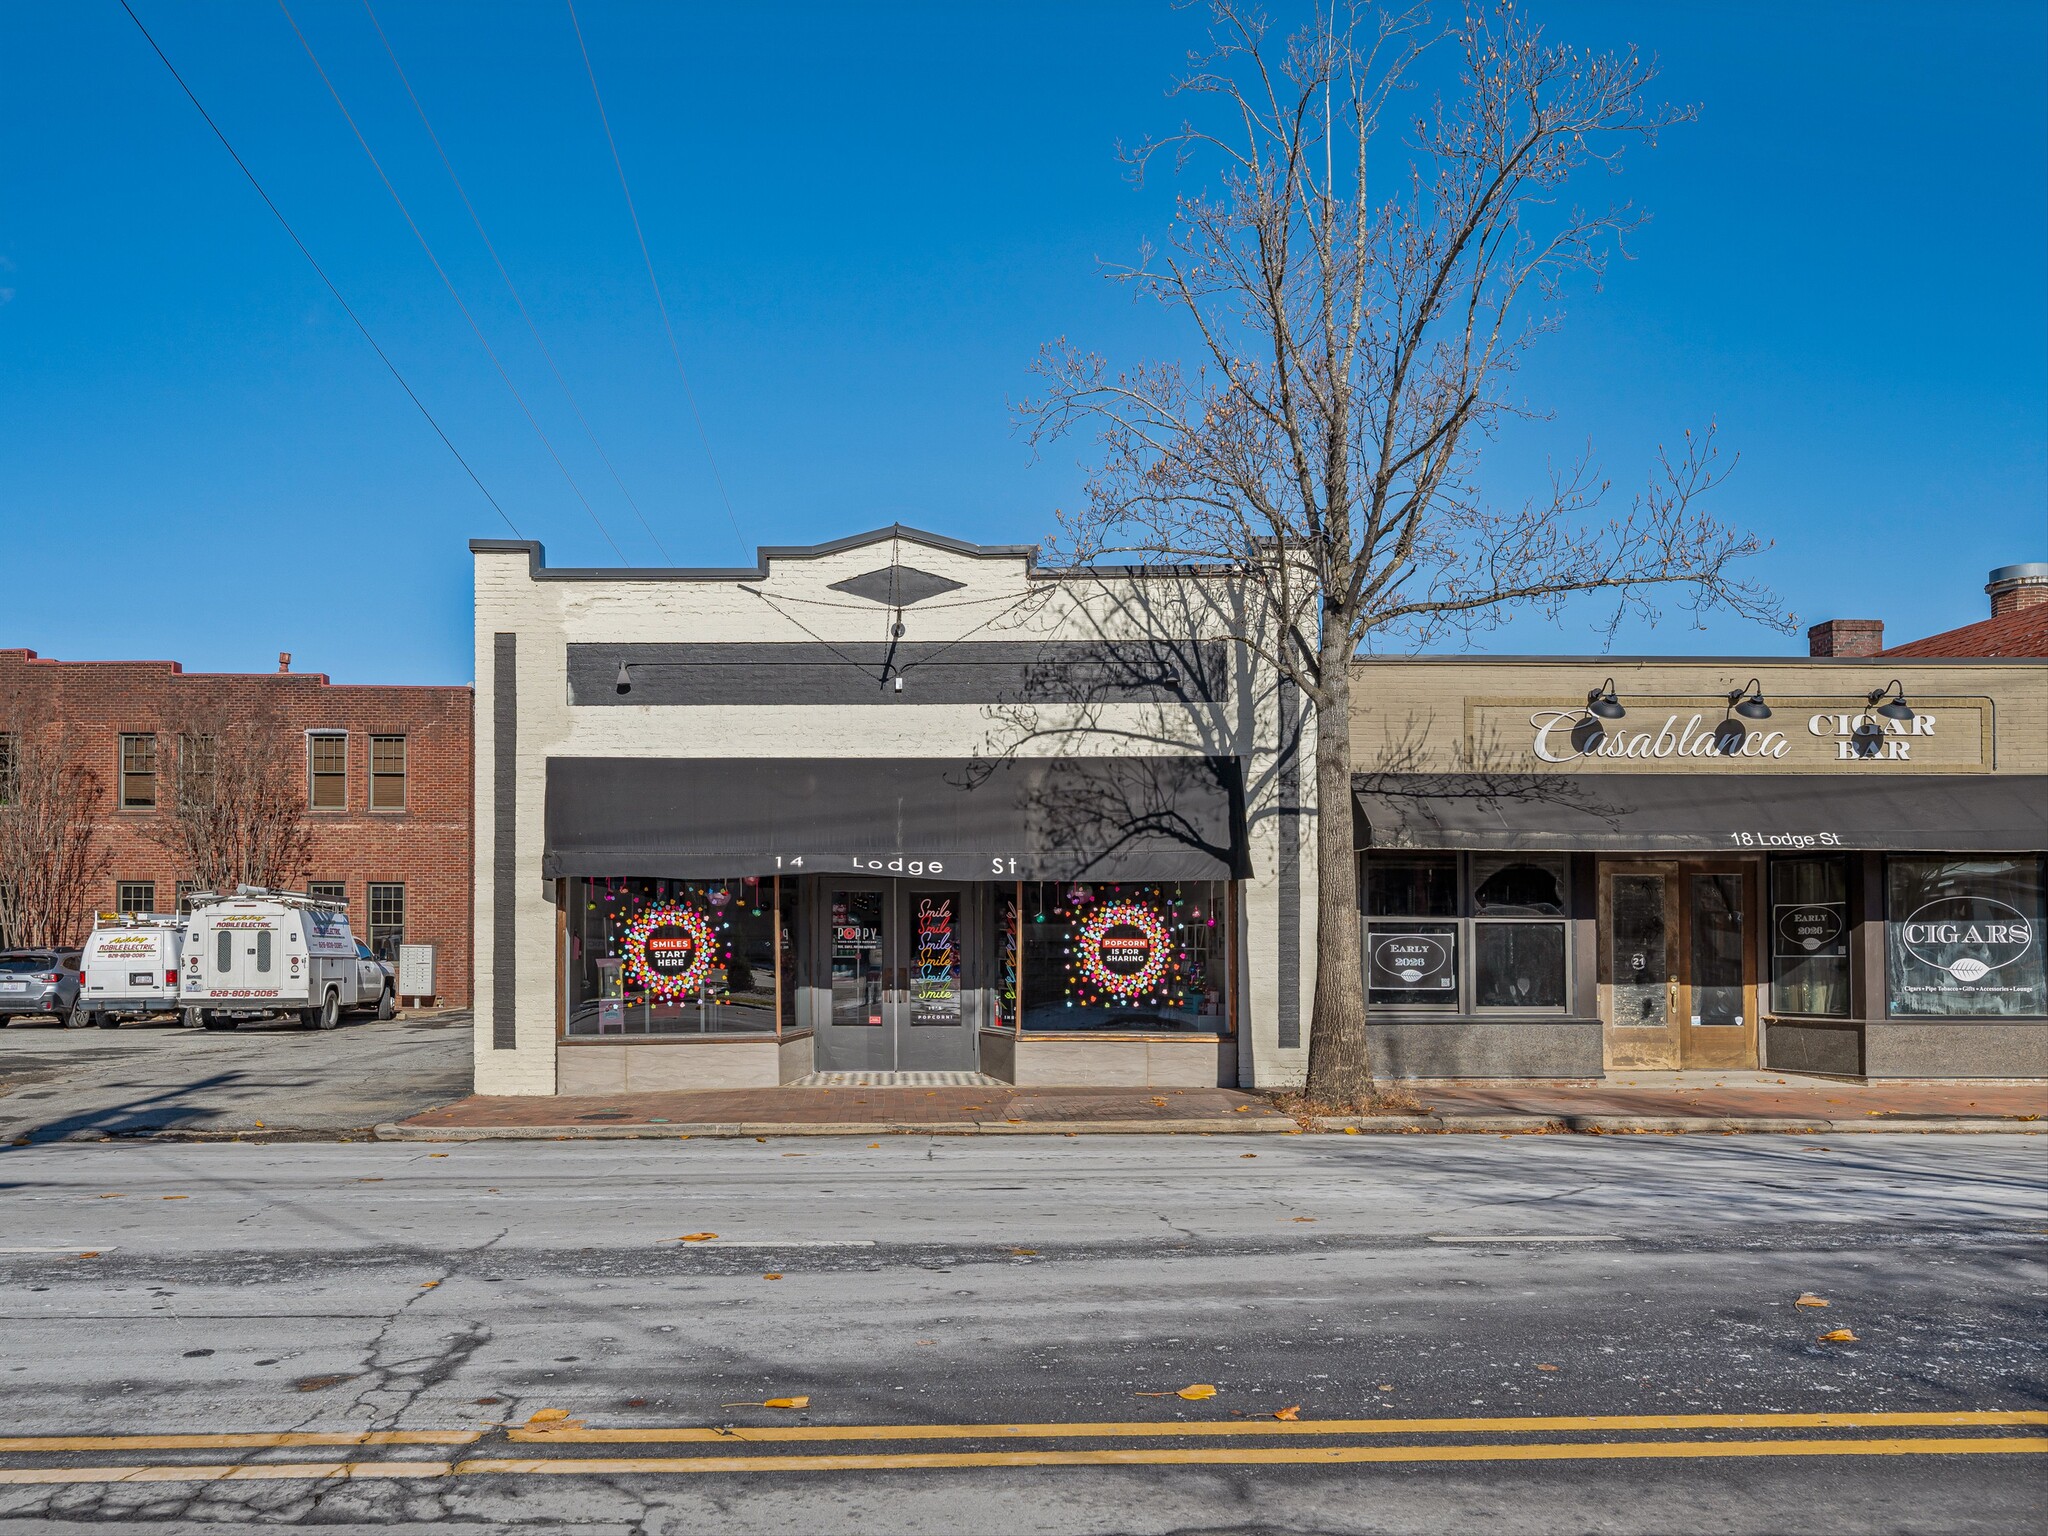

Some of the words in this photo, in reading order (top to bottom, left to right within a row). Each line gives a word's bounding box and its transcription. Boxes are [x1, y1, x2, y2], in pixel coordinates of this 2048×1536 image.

[1808, 713, 1937, 737] CIGAR
[1529, 709, 1792, 763] Casablanca
[1836, 740, 1911, 761] BAR
[1731, 832, 1754, 847] 18
[1758, 832, 1816, 850] Lodge
[1820, 832, 1842, 847] St
[775, 856, 804, 869] 14
[852, 857, 944, 876] Lodge
[991, 857, 1017, 875] St
[918, 898, 952, 918] Smile
[917, 915, 952, 935] Smile
[1794, 914, 1828, 922] EARLY
[837, 927, 877, 940] POPPY
[1797, 926, 1823, 935] 2026
[1904, 924, 2030, 944] CIGARS
[652, 940, 689, 949] SMILES
[918, 931, 952, 951] Smile
[1390, 944, 1430, 953] EARLY
[654, 950, 687, 959] START
[657, 958, 685, 967] HERE
[918, 948, 952, 967] Smile
[1394, 958, 1426, 967] 2026
[1632, 957, 1645, 966] 21
[918, 964, 952, 983] Smile
[210, 990, 279, 998] 828-808-0085
[918, 981, 952, 999] Smile
